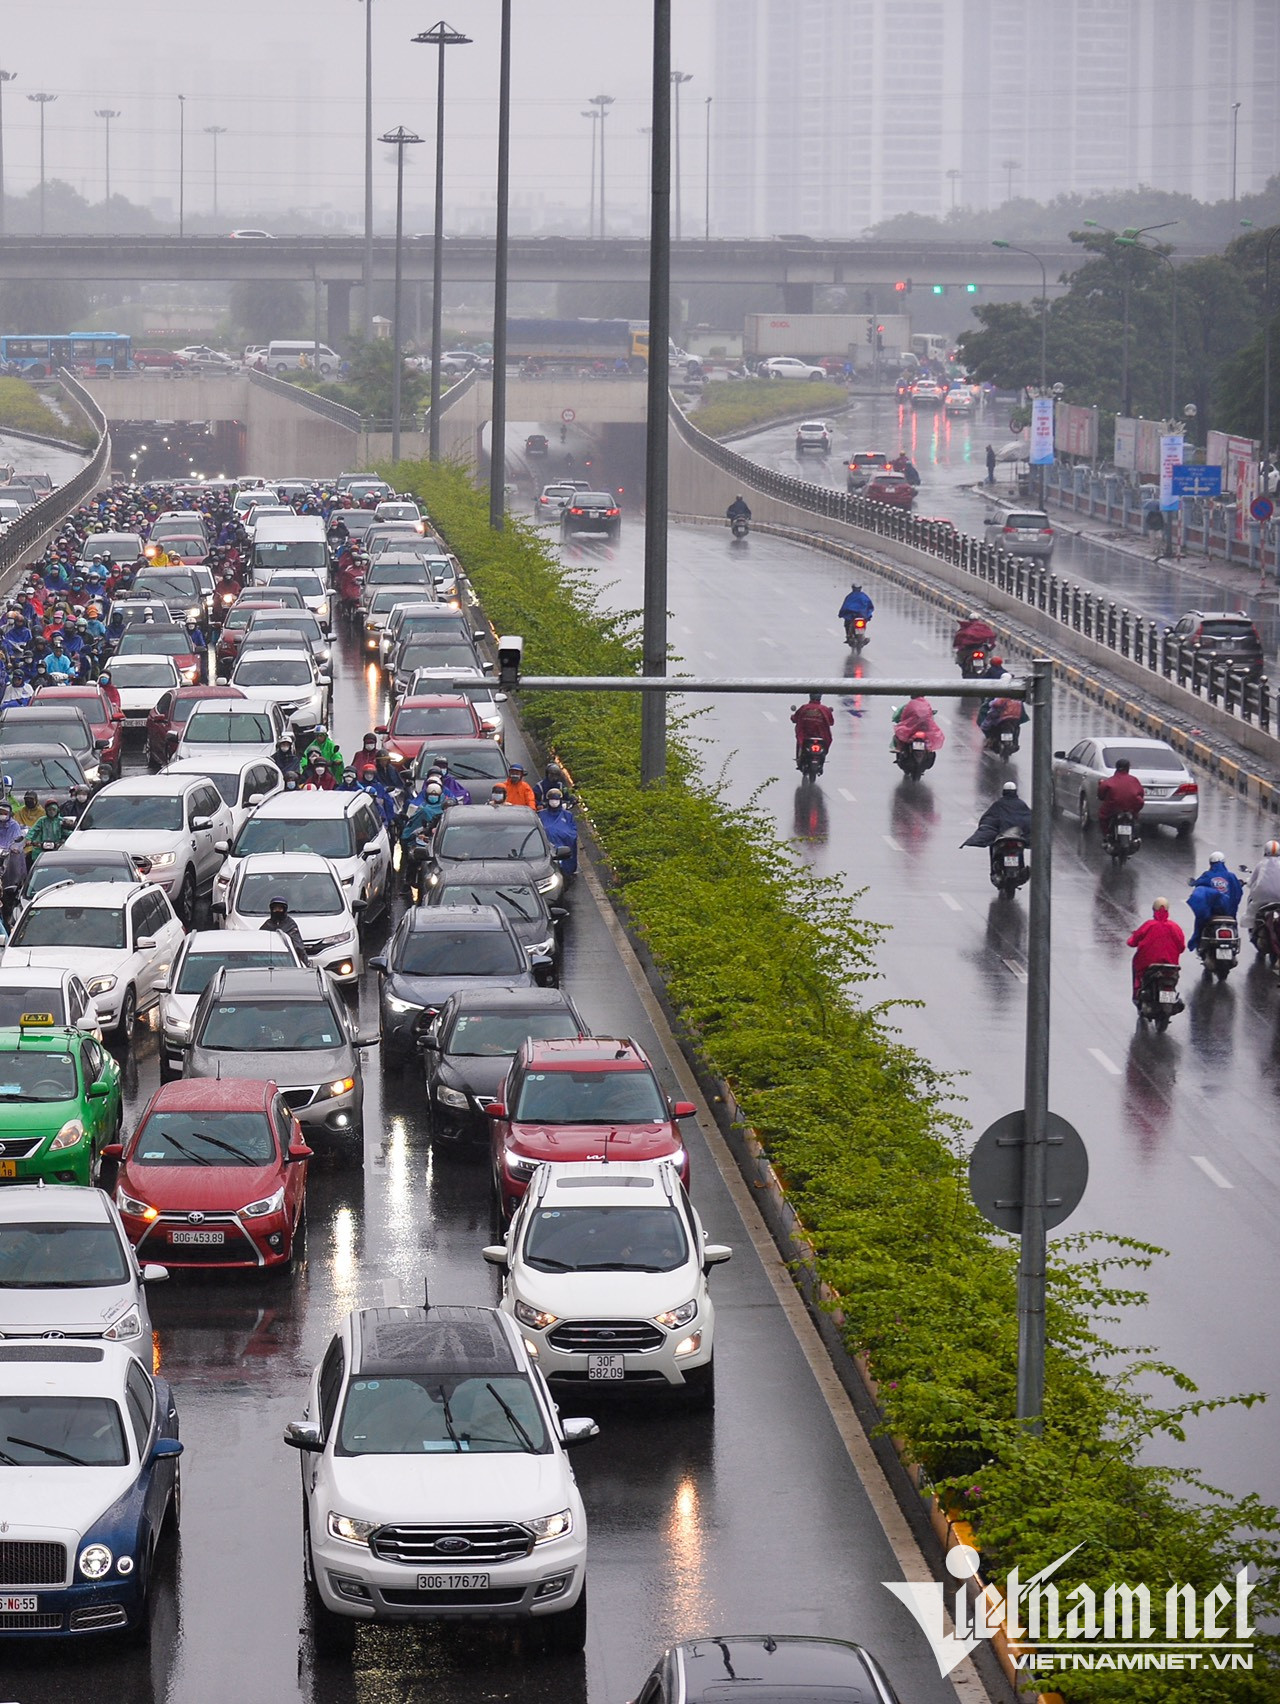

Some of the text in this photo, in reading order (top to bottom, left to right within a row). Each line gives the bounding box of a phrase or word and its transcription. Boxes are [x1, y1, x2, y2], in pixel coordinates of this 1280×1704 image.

[173, 1232, 224, 1243] 30G-453.89
[596, 1355, 616, 1367] 30F
[589, 1367, 623, 1379] 582.09
[419, 1574, 487, 1589] 30G-176.72
